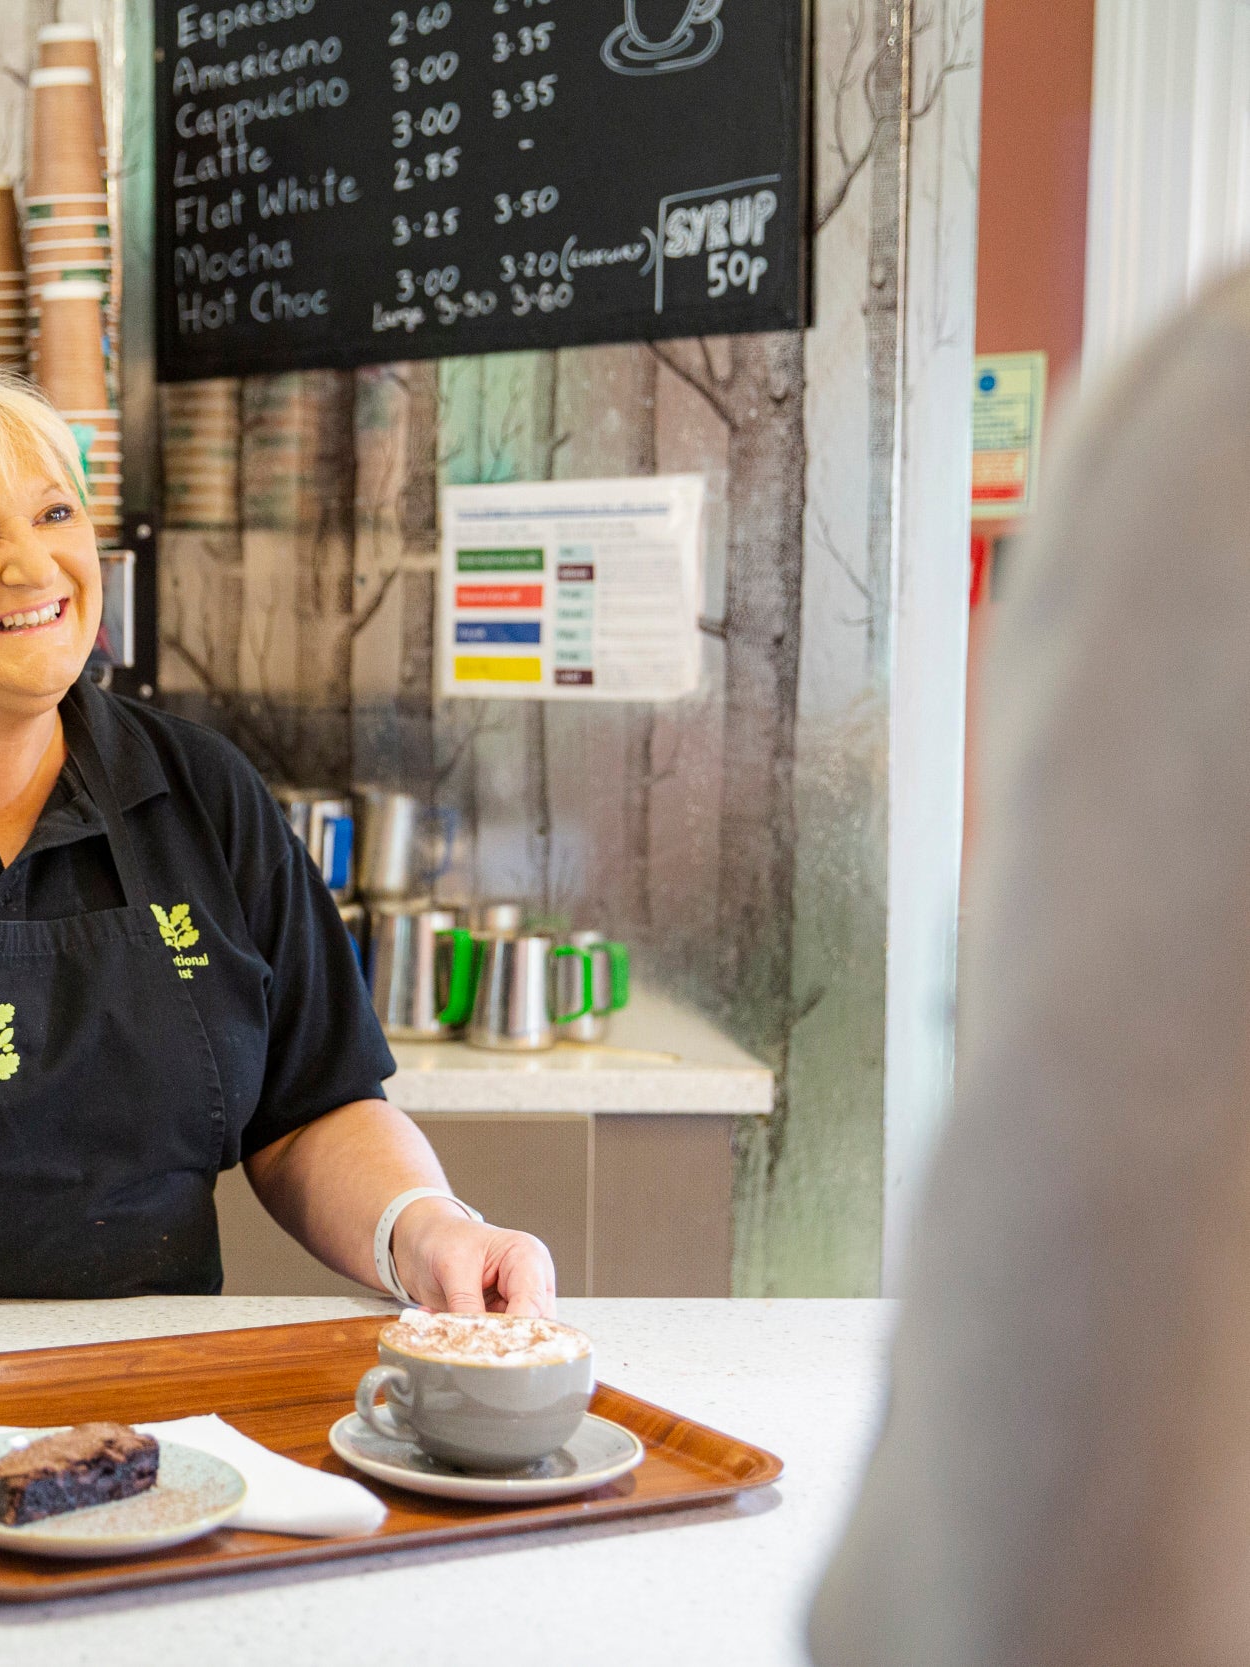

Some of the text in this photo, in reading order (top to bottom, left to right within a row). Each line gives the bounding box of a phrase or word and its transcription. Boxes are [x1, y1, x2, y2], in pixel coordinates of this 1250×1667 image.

[173, 2, 452, 96] Americano 2.60
[175, 77, 349, 144] Cappucino
[390, 51, 459, 92] 3.00
[174, 145, 271, 188] Latte
[392, 102, 461, 148] 3.00
[176, 189, 245, 236] Flat
[258, 166, 362, 219] White
[664, 190, 777, 258] SYRUP
[175, 232, 293, 286] Mocha
[393, 206, 461, 246] 3.25
[708, 249, 768, 298] 50p
[178, 288, 238, 333] Hot
[250, 281, 330, 323] Choc
[397, 265, 460, 302] 3.00
[173, 953, 209, 967] tional
